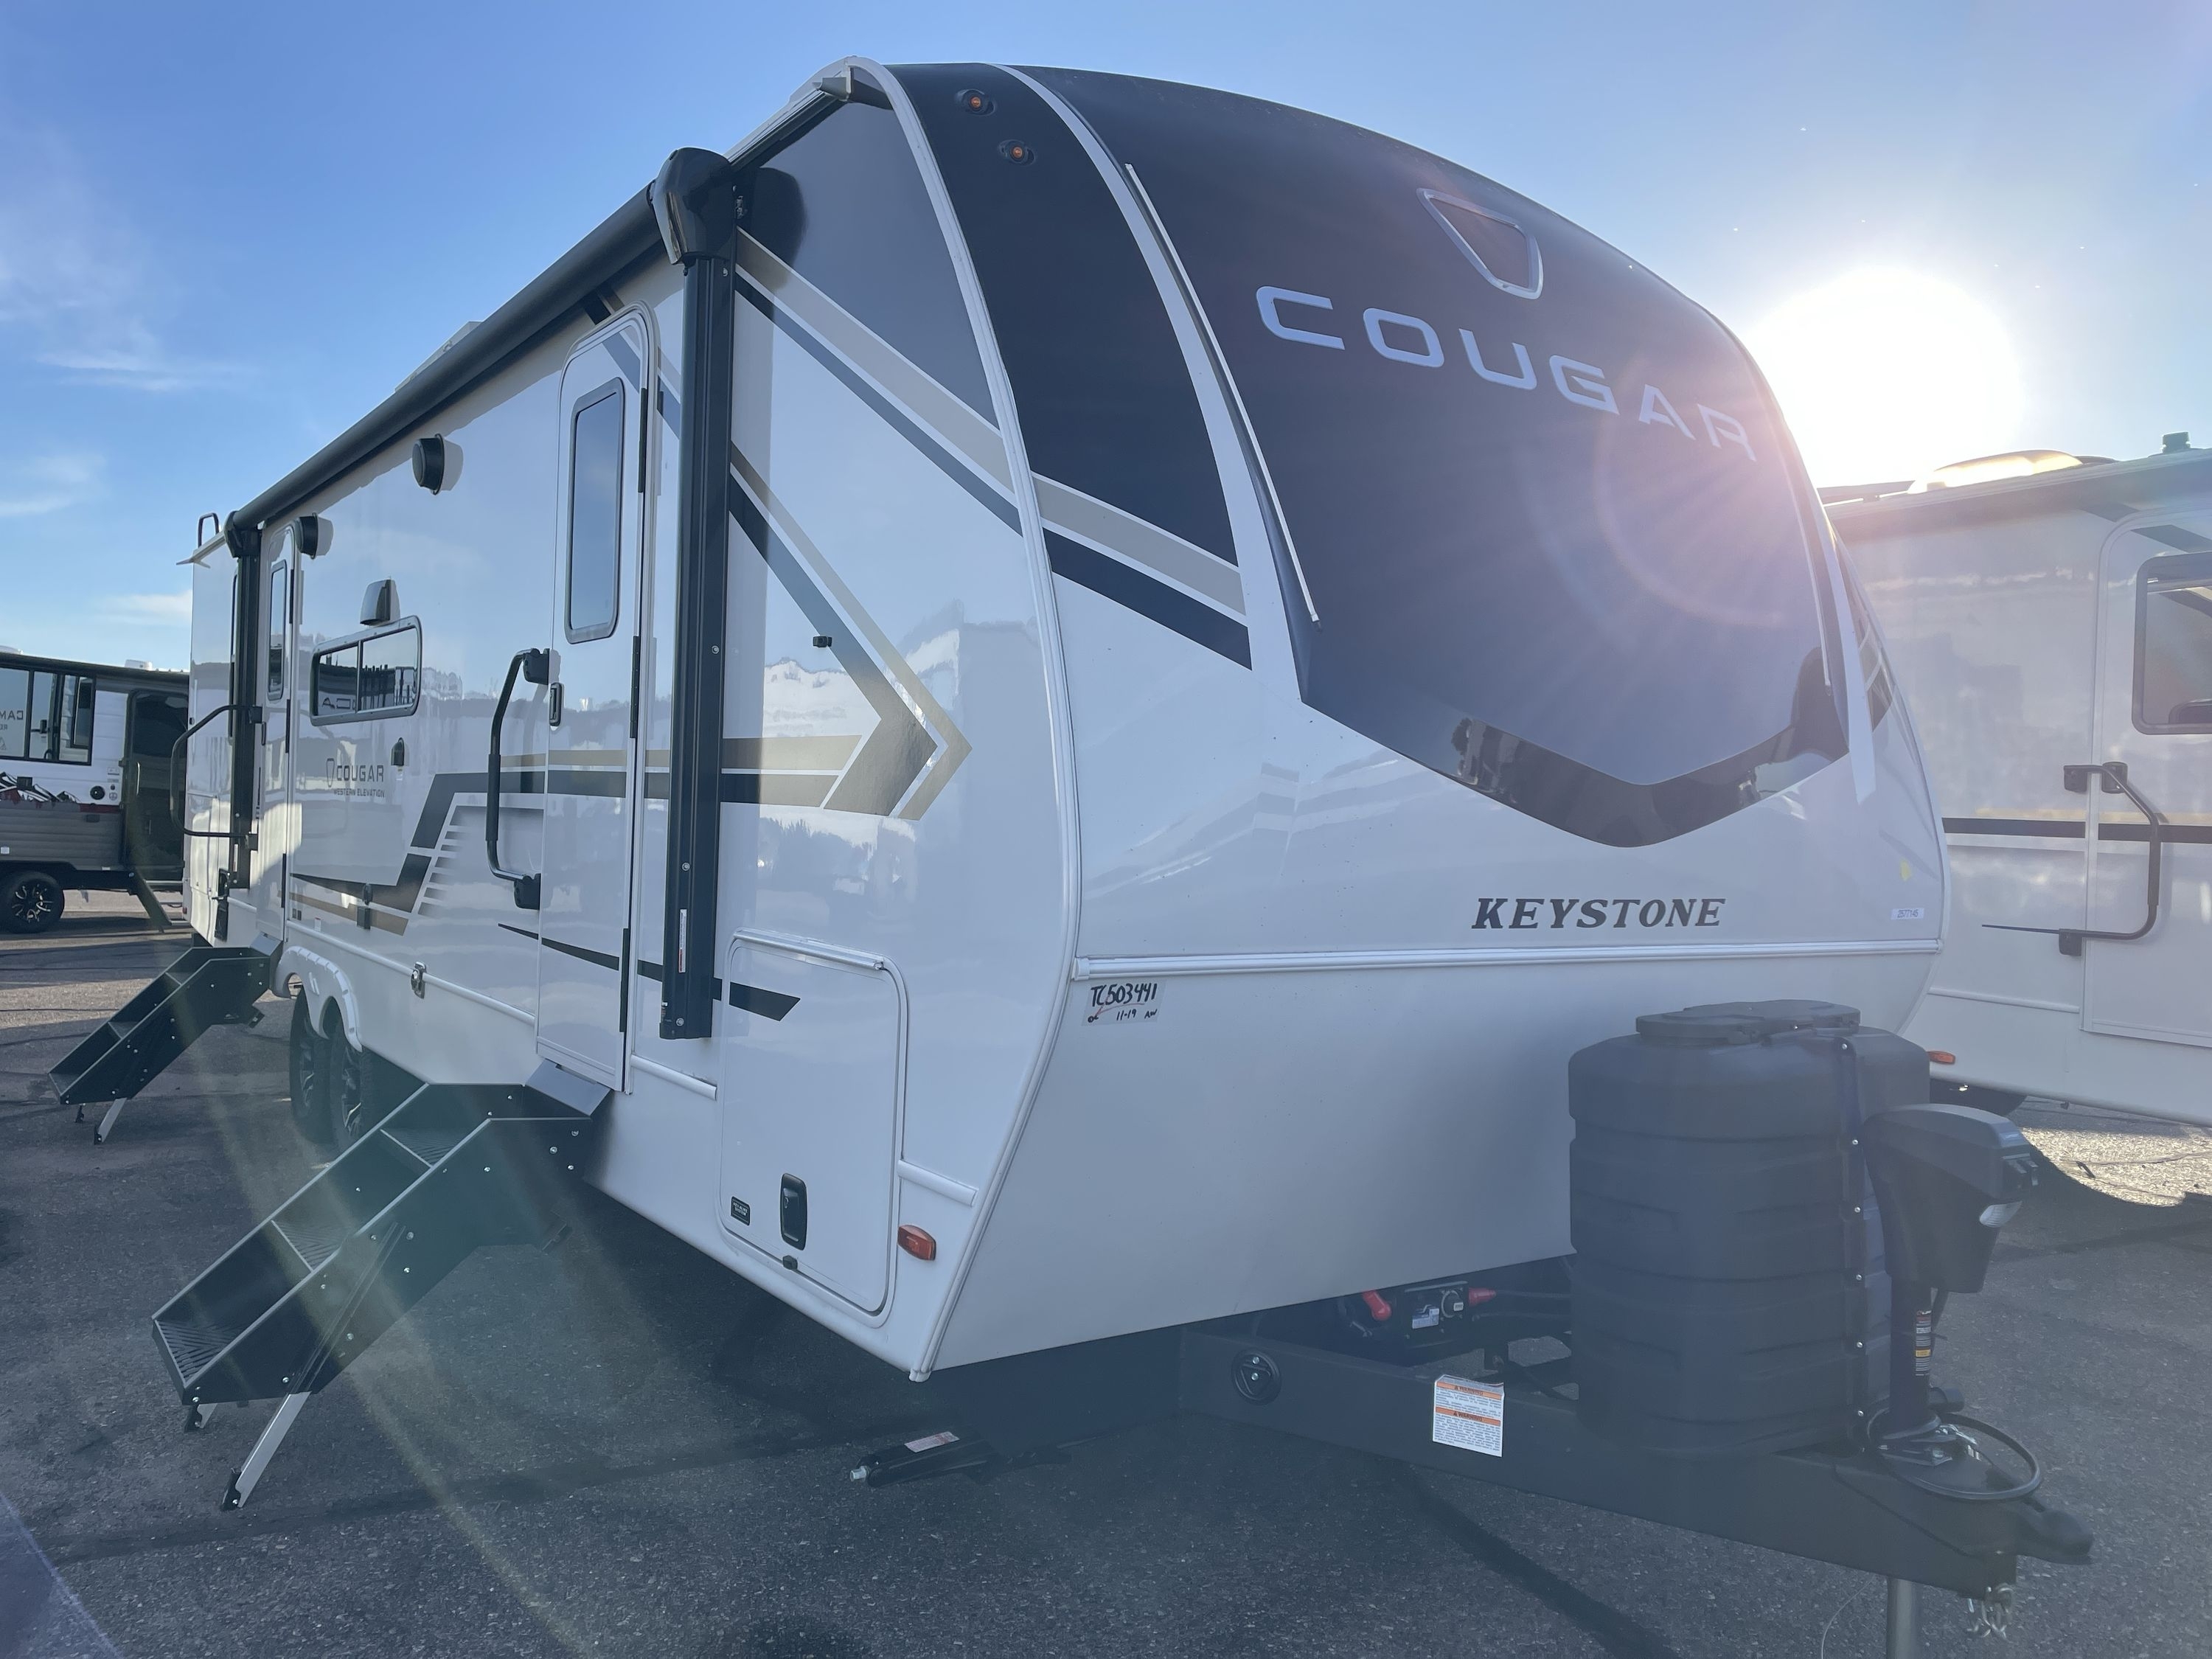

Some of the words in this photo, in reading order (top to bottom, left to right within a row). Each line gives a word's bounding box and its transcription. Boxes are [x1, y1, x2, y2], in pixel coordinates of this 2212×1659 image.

[1256, 285, 1757, 462] COUGAR
[337, 765, 384, 782] COUGAR
[357, 788, 385, 798] ELEVATION
[1472, 898, 1726, 929] KEYSTONE
[1091, 983, 1158, 1007] TC503441
[1116, 1009, 1137, 1020] 11-19
[1458, 1412, 1483, 1422] WARNING
